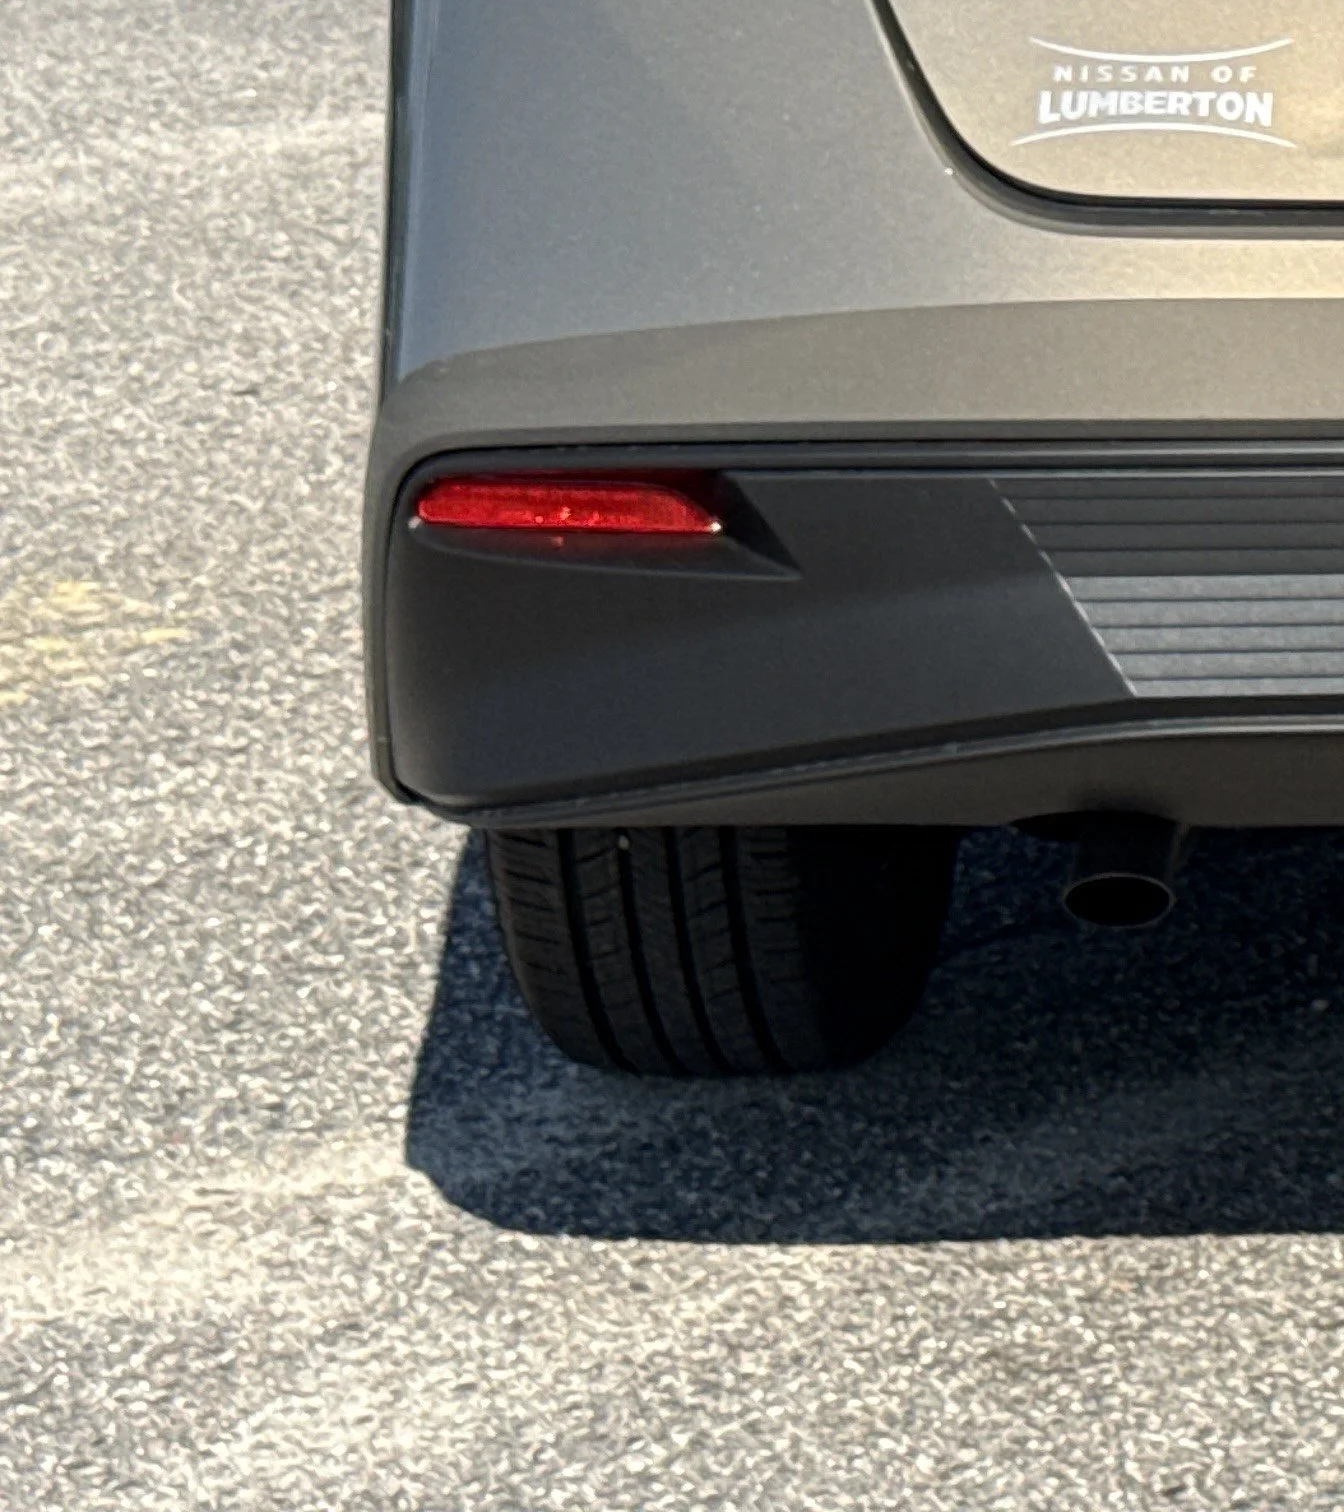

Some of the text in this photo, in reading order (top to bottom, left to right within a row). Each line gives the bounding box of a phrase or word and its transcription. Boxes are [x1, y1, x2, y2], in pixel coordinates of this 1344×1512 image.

[1053, 64, 1258, 84] NISSAN OF
[1038, 90, 1274, 127] LUMBERTON
